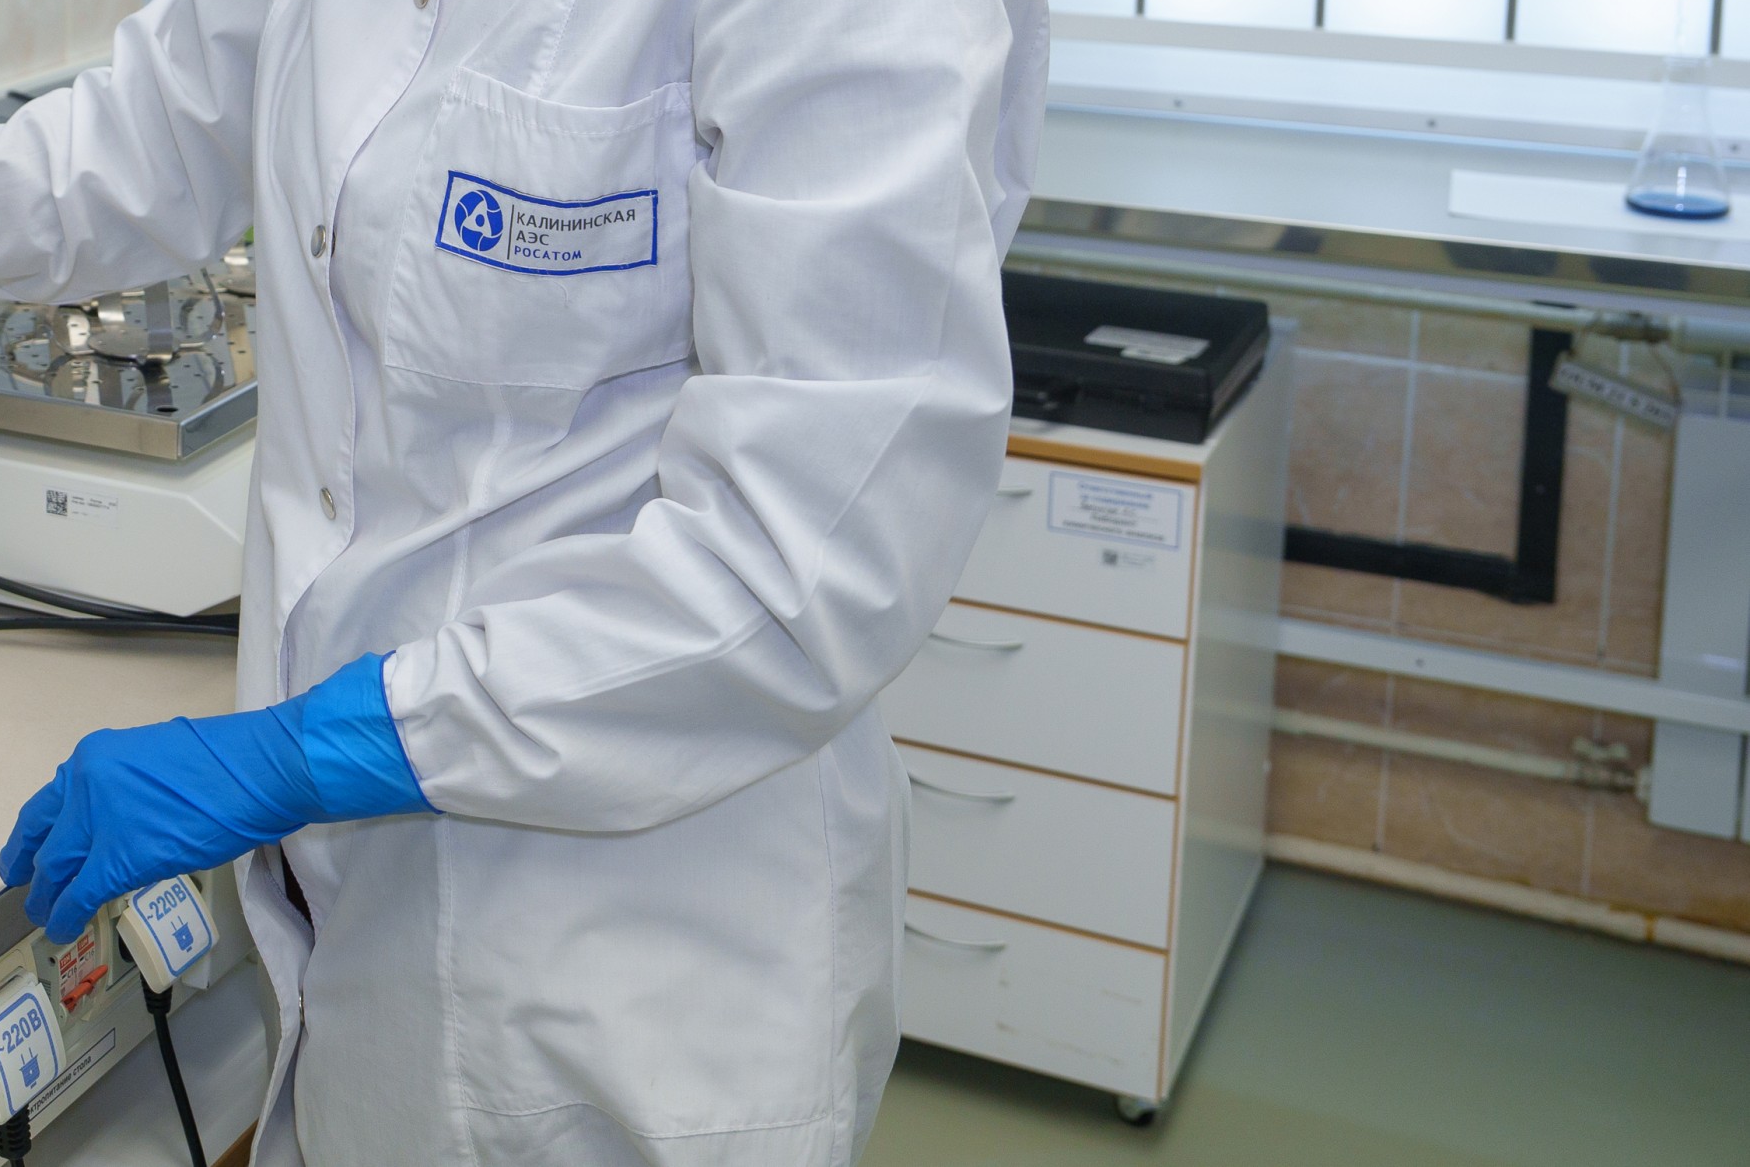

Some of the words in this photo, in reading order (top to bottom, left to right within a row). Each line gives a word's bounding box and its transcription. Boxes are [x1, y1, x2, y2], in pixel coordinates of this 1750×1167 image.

[516, 208, 636, 232] КАЛИНИНСКАЯ
[516, 231, 550, 246] АЭС
[513, 245, 582, 261] РОСАТОМ
[30, 1073, 72, 1114] ктропитание
[73, 1055, 92, 1076] стола
